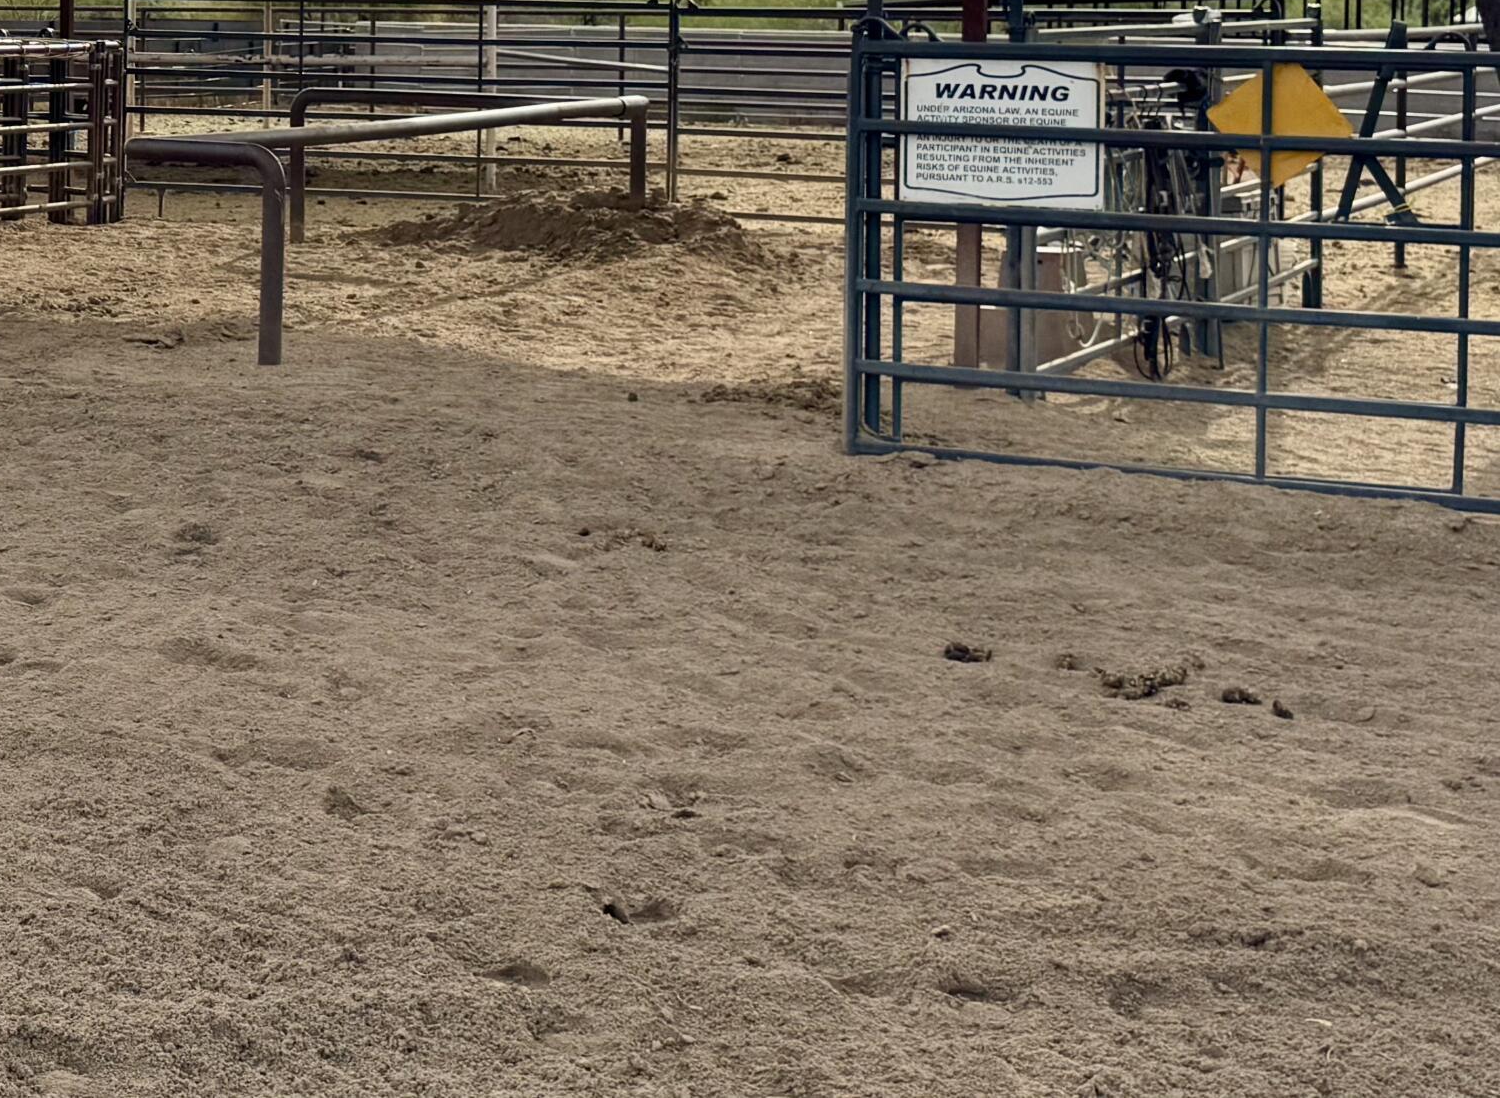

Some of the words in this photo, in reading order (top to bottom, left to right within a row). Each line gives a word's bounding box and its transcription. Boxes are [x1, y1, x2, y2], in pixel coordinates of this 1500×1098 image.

[935, 82, 1070, 102] WARNING
[952, 105, 996, 114] ARIZONA
[1041, 108, 1080, 117] EQUINE
[962, 115, 1010, 125] SPONSOR
[1012, 117, 1027, 125] OR
[1029, 118, 1067, 127] EQUINE
[916, 143, 978, 152] PARTICIPANT
[980, 145, 990, 153] IN
[993, 145, 1029, 155] EQUINE
[1032, 147, 1086, 157] ACTIVITIES
[916, 153, 970, 162] RESULTING
[972, 155, 1001, 163] FROM
[1004, 156, 1022, 165] THE
[1025, 157, 1075, 166] INHERENT
[916, 162, 945, 171] RISKS
[963, 164, 999, 173] EQUINE
[1002, 166, 1058, 177] ACTIVITIES,
[916, 172, 968, 181] PURSUANT
[971, 174, 984, 182] TO
[986, 175, 1015, 184] A.R.S.
